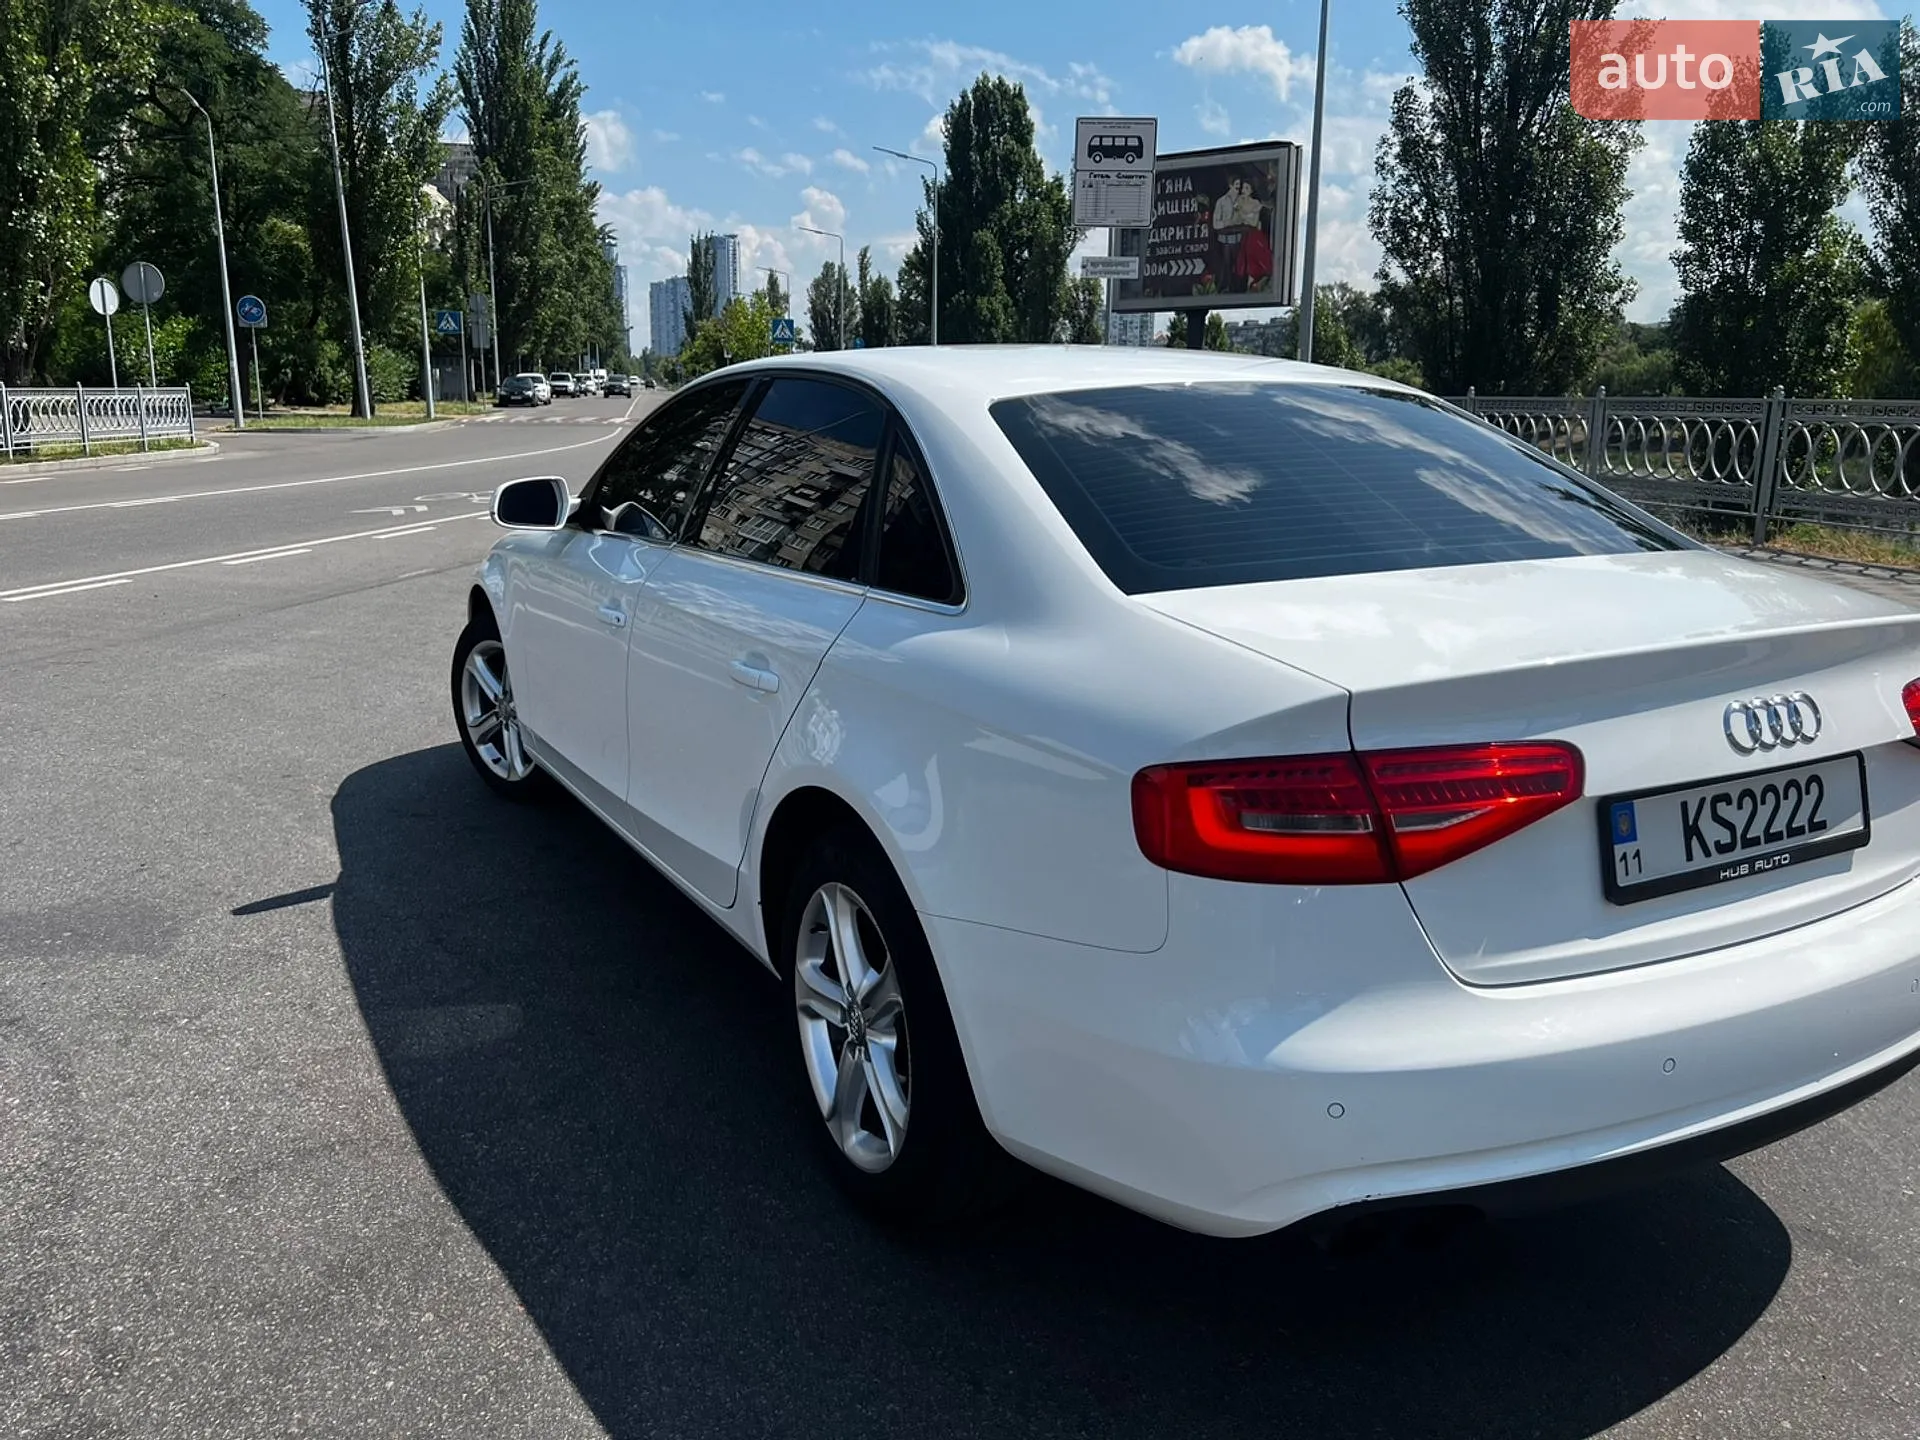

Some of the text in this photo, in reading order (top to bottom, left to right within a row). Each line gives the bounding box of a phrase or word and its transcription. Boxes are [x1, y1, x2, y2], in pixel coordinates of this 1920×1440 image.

[1680, 774, 1828, 862] KS2222
[1619, 848, 1643, 877] 11
[1720, 853, 1791, 879] HUB AUTO
